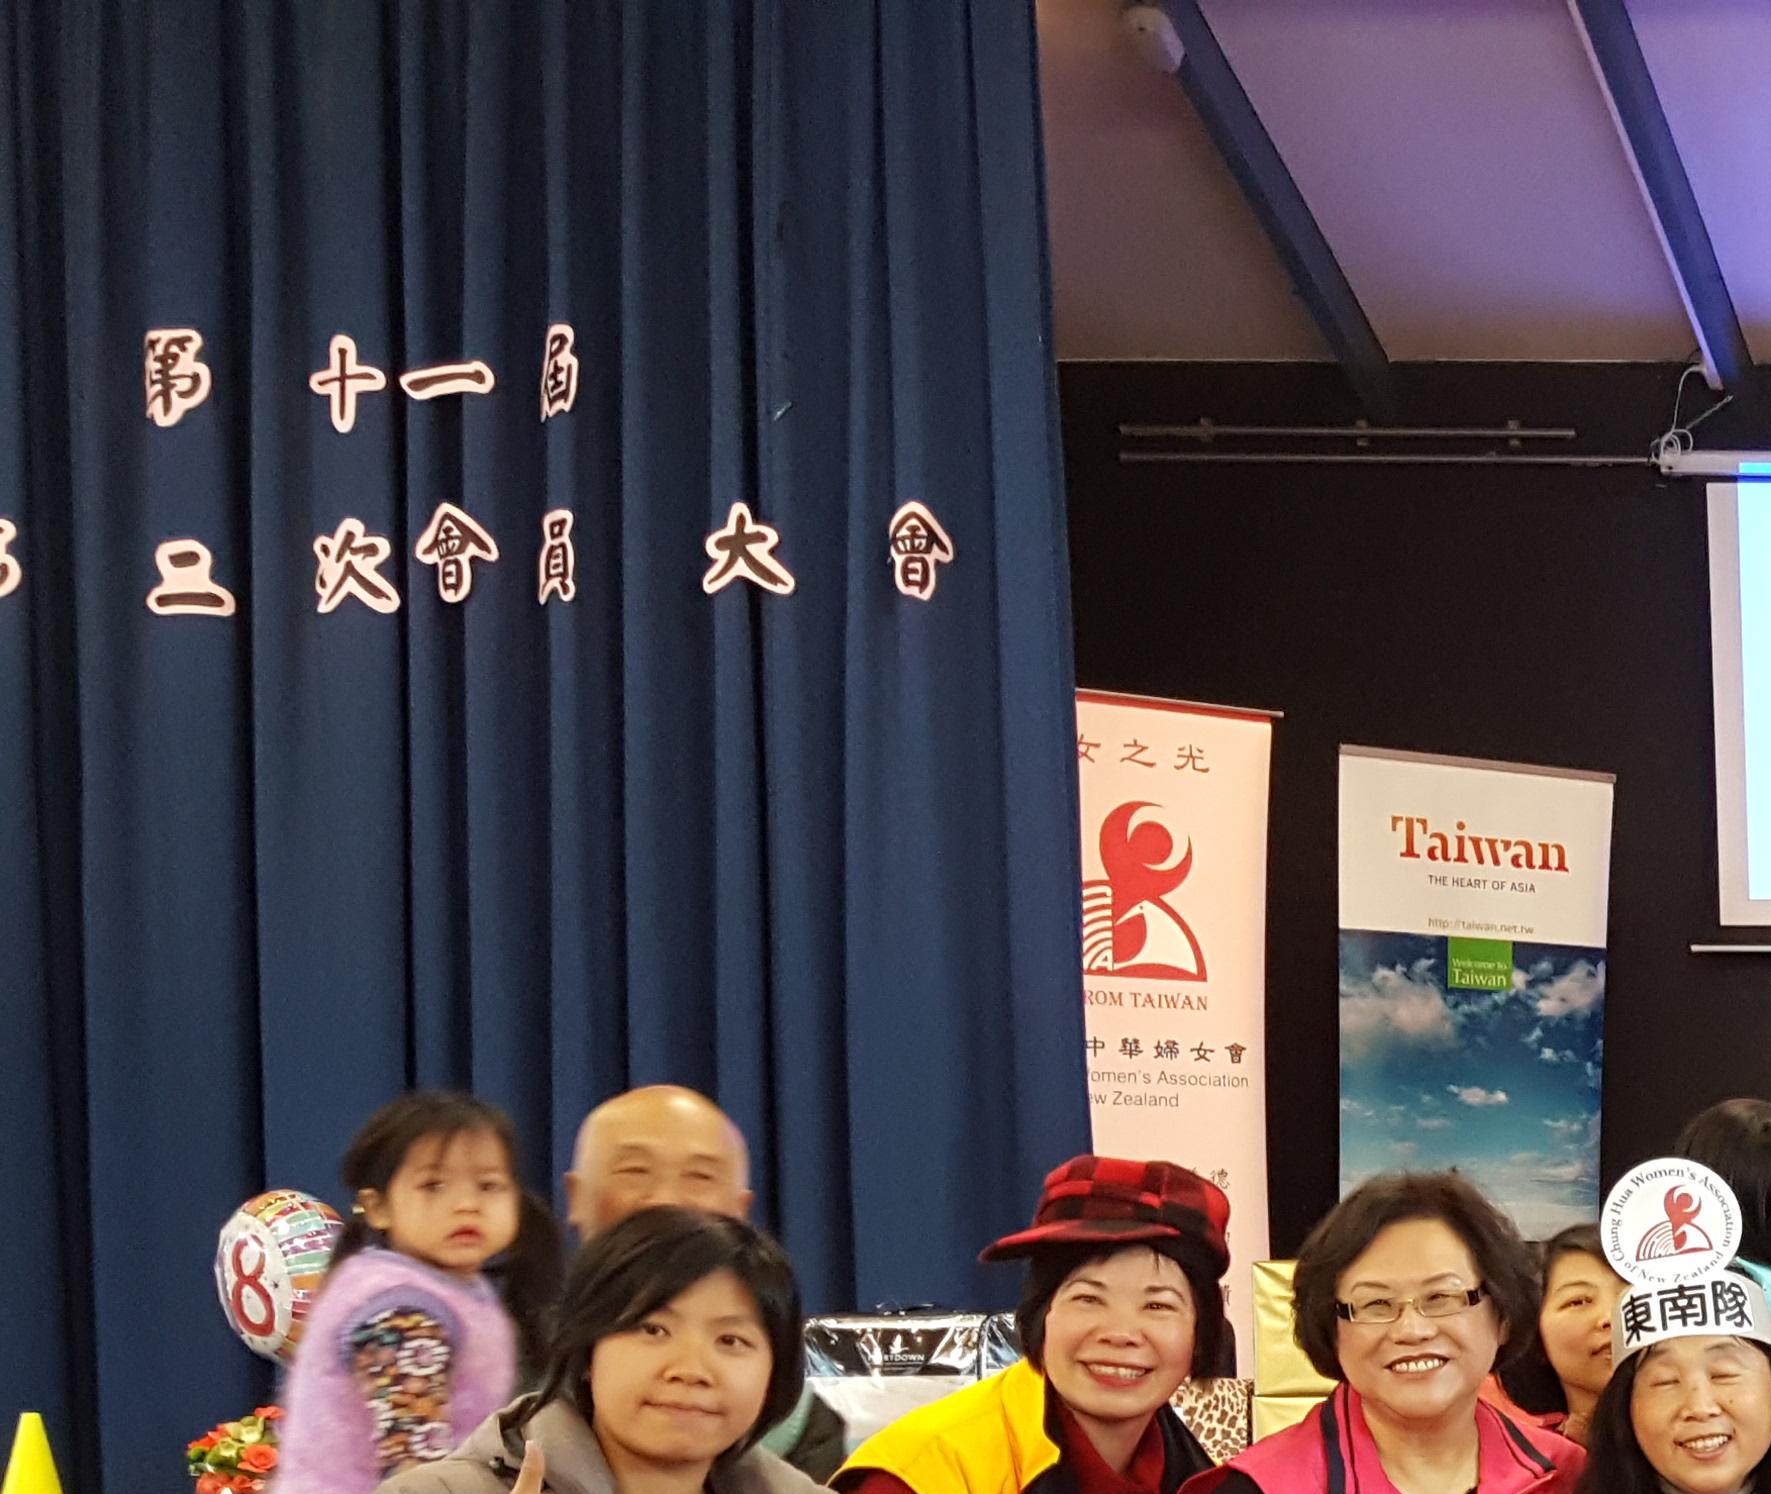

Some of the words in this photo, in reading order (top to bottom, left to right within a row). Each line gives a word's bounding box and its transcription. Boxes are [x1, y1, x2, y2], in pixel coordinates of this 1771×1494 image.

[0, 501, 954, 615] 二次會員大會
[1391, 815, 1570, 872] Taiwan
[1428, 874, 1449, 887] THE
[1452, 877, 1488, 890] HEART
[1491, 880, 1507, 891] OF
[1511, 882, 1536, 894] ASIA
[1453, 968, 1508, 987] Taiwan
[1130, 993, 1208, 1011] TAIWAN
[1088, 1071, 1152, 1084] omen's
[1157, 1070, 1249, 1088] Association
[1112, 1091, 1179, 1107] Zealand
[1631, 1166, 1696, 1189] Women's
[1610, 1188, 1634, 1216] Hua
[1699, 1175, 1734, 1248] Association
[1610, 1219, 1624, 1262] Chung
[1624, 1261, 1638, 1274] of
[1639, 1269, 1667, 1284] New
[1673, 1250, 1724, 1284] Zealand
[231, 1233, 276, 1338] 8
[1621, 1280, 1753, 1347] 東南隊
